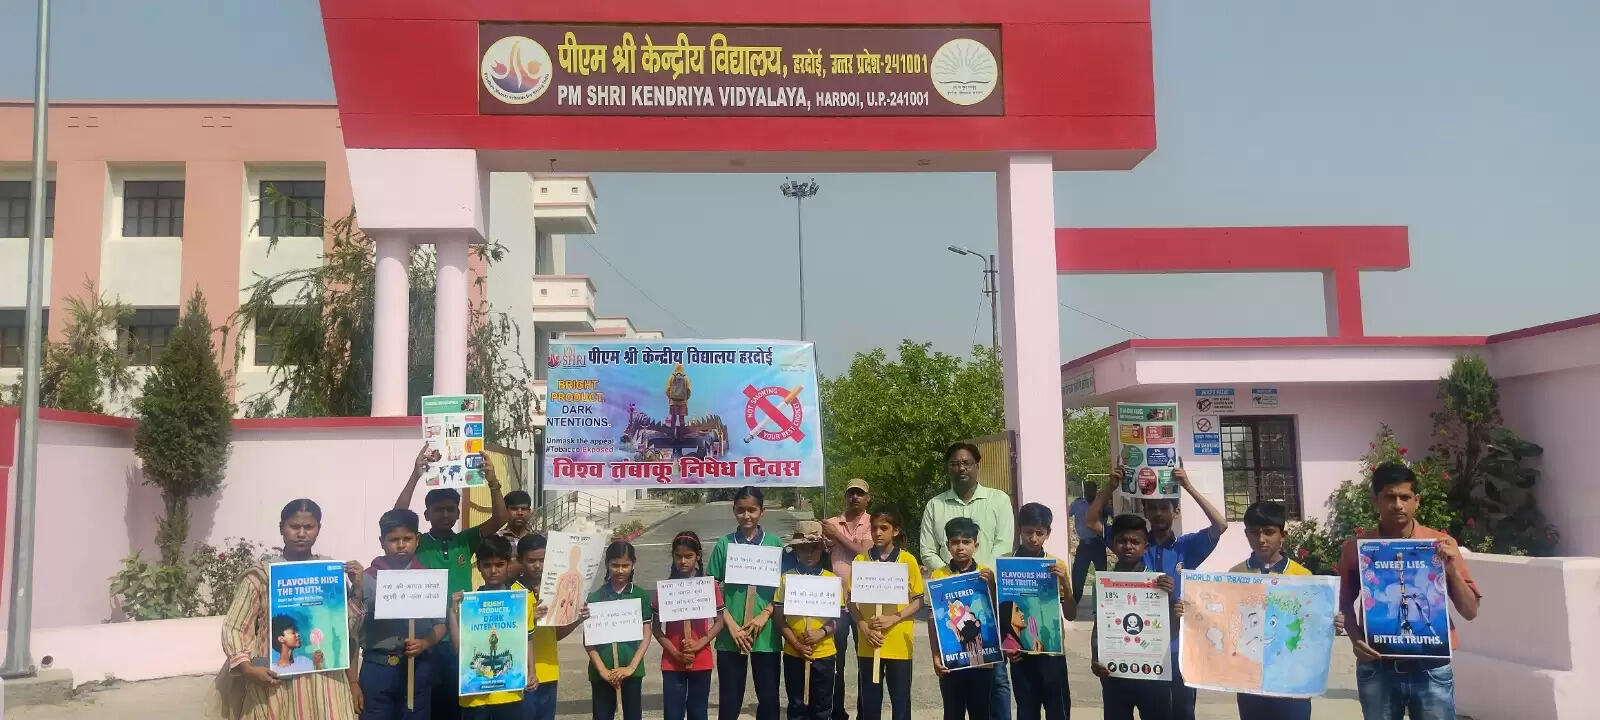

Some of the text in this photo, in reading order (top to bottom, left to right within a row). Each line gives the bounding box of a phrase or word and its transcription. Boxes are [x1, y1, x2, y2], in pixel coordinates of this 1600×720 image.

[557, 31, 608, 76] पीएम
[612, 31, 637, 74] श्री
[640, 32, 706, 80] केन्द्रीय
[709, 32, 788, 79] विद्यालय,
[558, 85, 582, 106] PM
[587, 85, 626, 106] SHRI
[631, 85, 714, 107] KENDRIYA
[719, 86, 811, 111] VIDYALAYA,
[816, 92, 864, 109] HARDOI,
[867, 91, 929, 107] U.P.-241001
[562, 355, 587, 366] SHRI
[588, 346, 773, 366] पीएम श्री केन्द्रीय विद्यालय हरदोई
[557, 380, 600, 390] BRIGHT
[746, 388, 778, 418] NOT SMOKING
[562, 405, 593, 414] DARK
[763, 431, 781, 441] YOUR
[781, 426, 795, 438] BEST
[553, 456, 802, 484] विश्व तंबाकू निषेध दिवस
[1374, 560, 1428, 569] SWEET LIES.
[1001, 571, 1035, 579] FLAVOURS
[1185, 574, 1211, 582] WORLD
[277, 575, 339, 587] FLAVOURS HIDE
[1015, 579, 1039, 587] TRUTH.
[277, 586, 324, 596] THE TRUTH.
[944, 588, 975, 600] FILTERED
[1104, 591, 1119, 599] 18%
[1145, 592, 1160, 600] 12%
[1373, 635, 1443, 645] BITTER TRUTHS.
[945, 653, 959, 662] BUT
